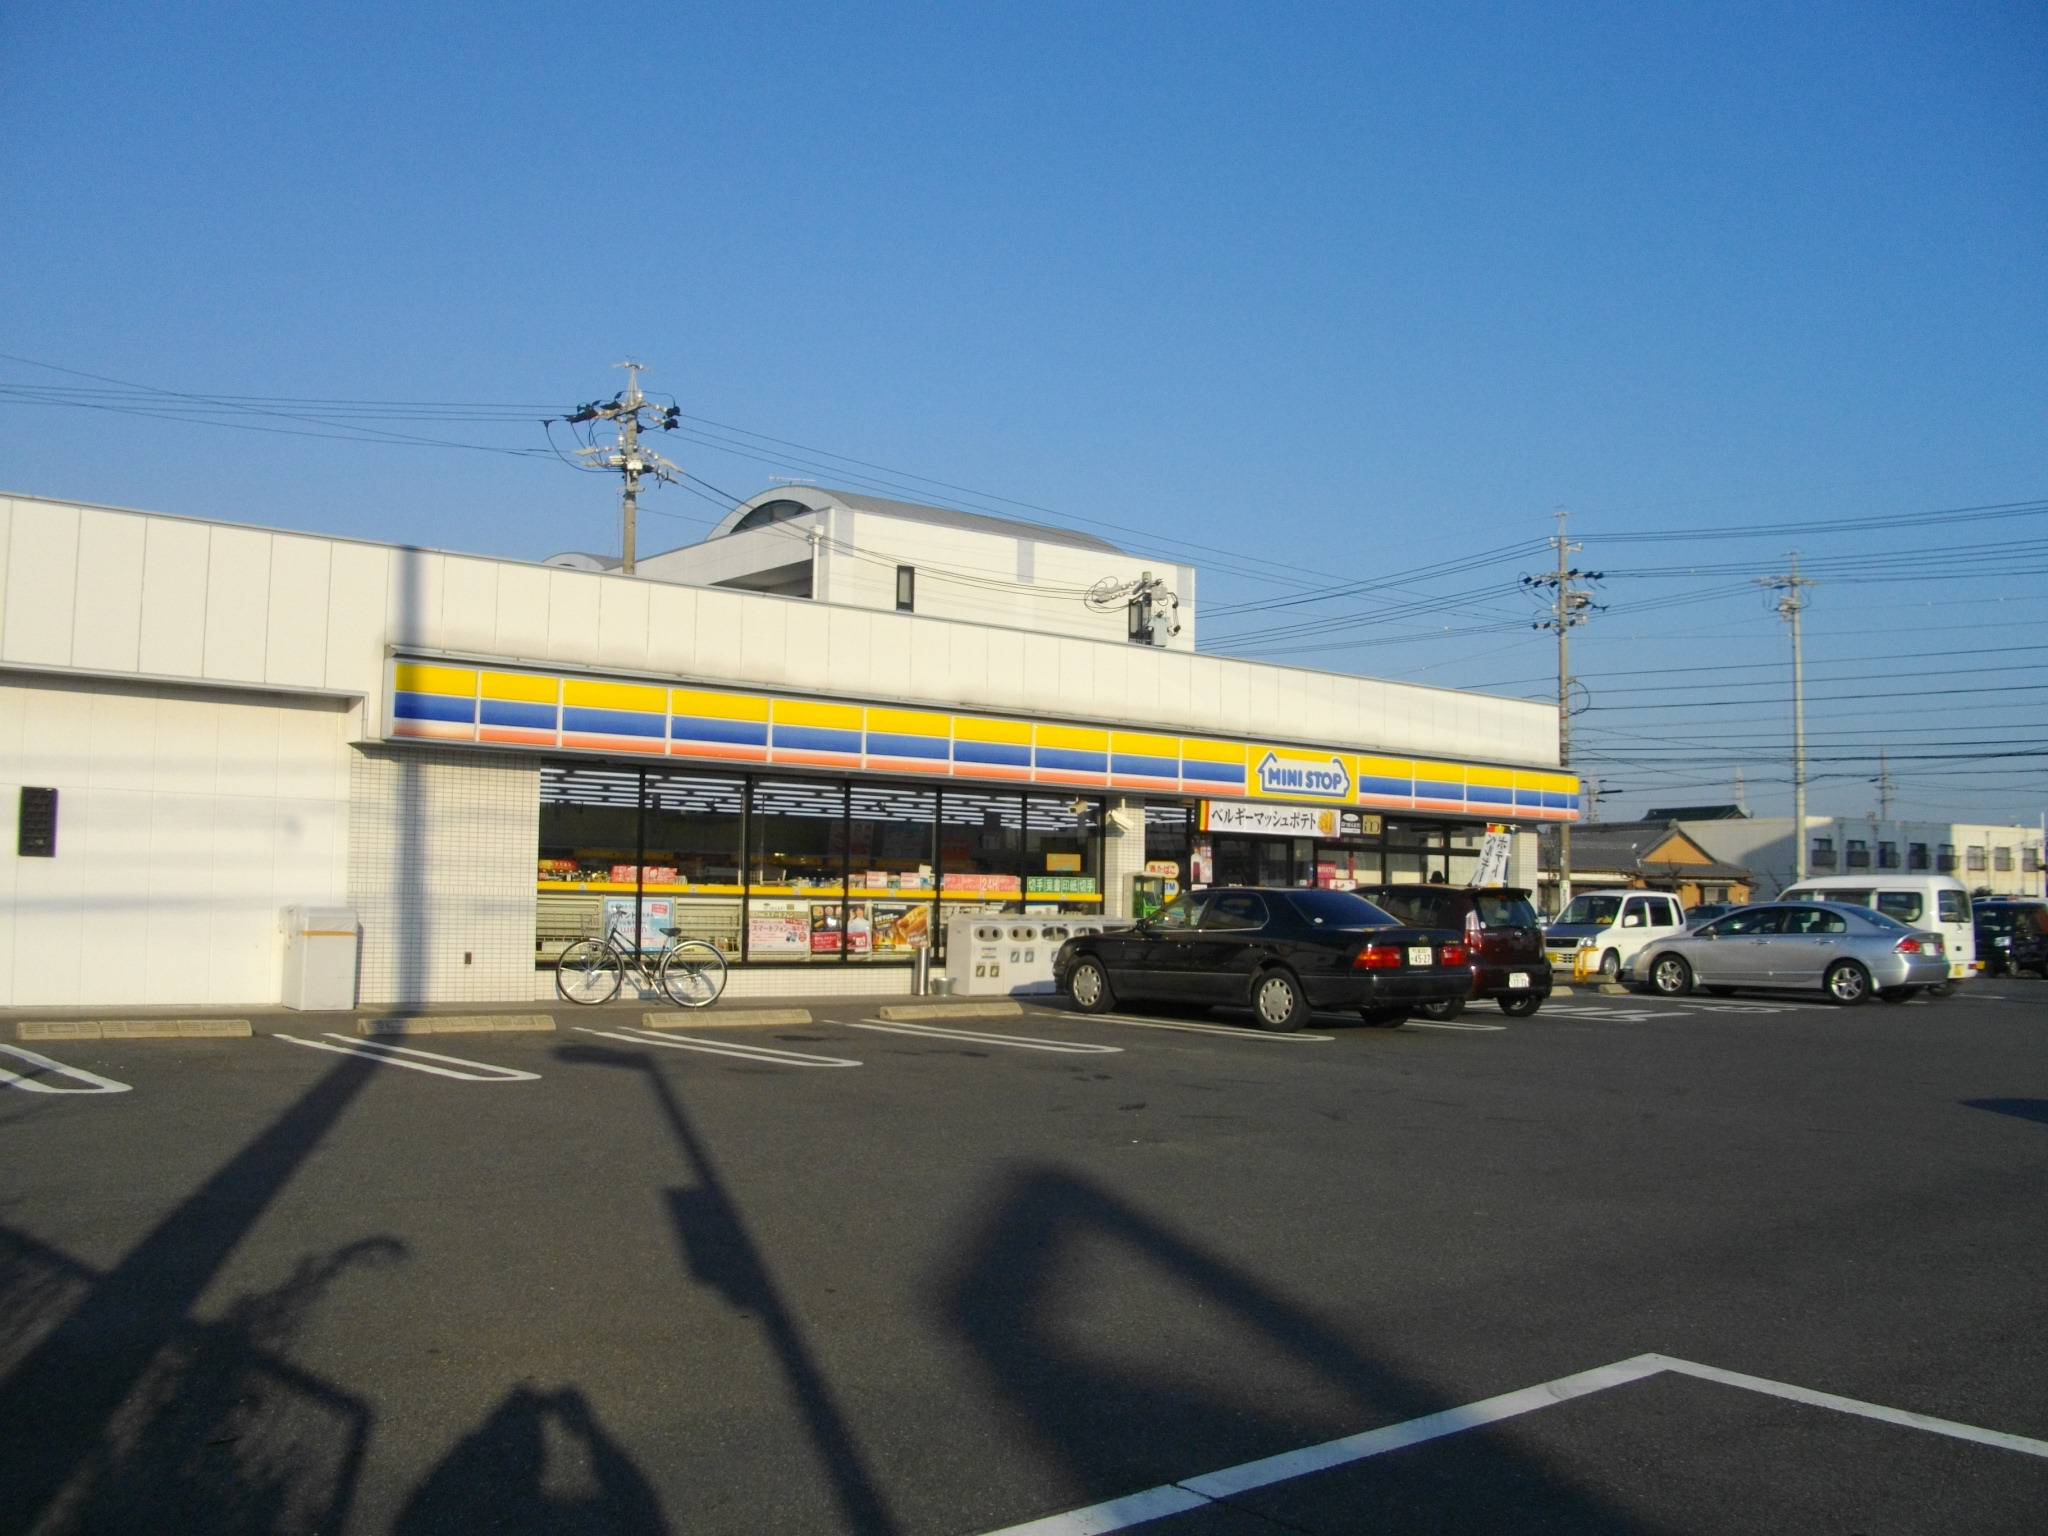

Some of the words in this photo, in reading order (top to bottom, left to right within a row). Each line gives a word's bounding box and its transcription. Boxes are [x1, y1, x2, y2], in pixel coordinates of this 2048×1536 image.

[1268, 767, 1303, 788] MINI
[1305, 770, 1342, 790] STOP
[1211, 807, 1316, 830] ベルギーマッシュポテト
[1364, 821, 1380, 833] iD
[981, 878, 998, 891] 24H
[1028, 878, 1044, 893] 切手
[1062, 879, 1078, 894] 印紙
[1079, 879, 1095, 894] 切手
